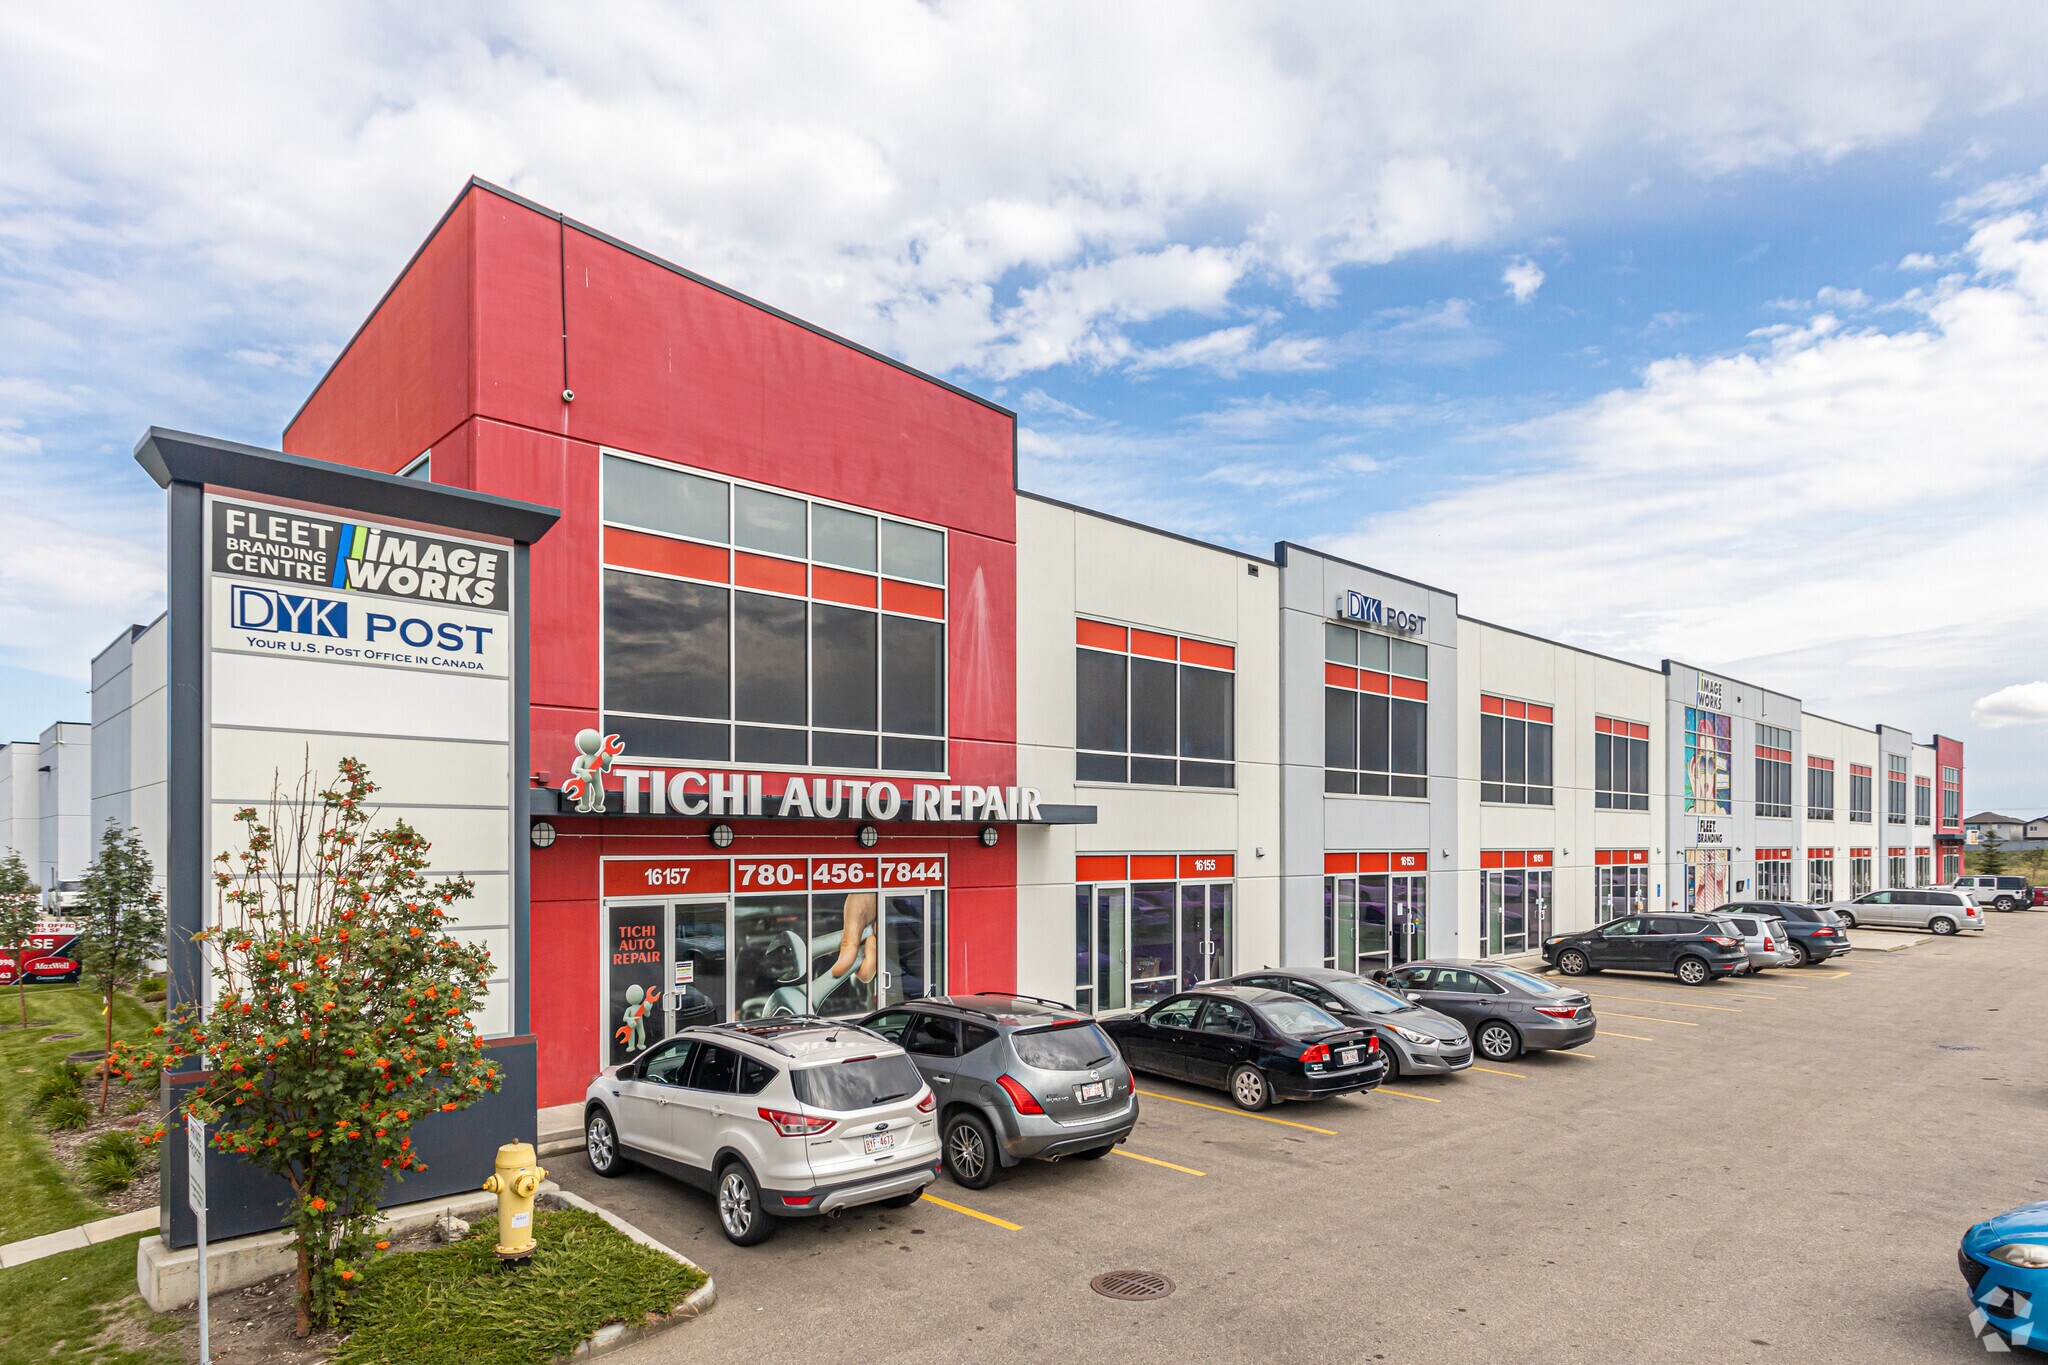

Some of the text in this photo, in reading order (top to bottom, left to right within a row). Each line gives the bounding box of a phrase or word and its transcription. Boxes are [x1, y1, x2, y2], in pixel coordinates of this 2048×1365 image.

[226, 509, 333, 548] FLEET
[226, 537, 326, 563] BRANDING
[226, 553, 326, 582] CENTRE
[346, 559, 495, 605] WORKS
[237, 589, 493, 655] DYK POST
[1350, 592, 1426, 634] DYK POST
[291, 642, 320, 653] U.S.
[1698, 692, 1721, 710] WORKS
[613, 769, 1042, 821] TICHI AUTO REPAIR
[1700, 819, 1716, 832] FLEET
[1698, 833, 1722, 843] BRANDING
[881, 862, 942, 881] 7844
[1194, 859, 1215, 871] 16155
[644, 867, 691, 885] 16157
[618, 925, 656, 938] TICHI
[618, 938, 656, 951] AUTO
[613, 951, 661, 965] REPAIR
